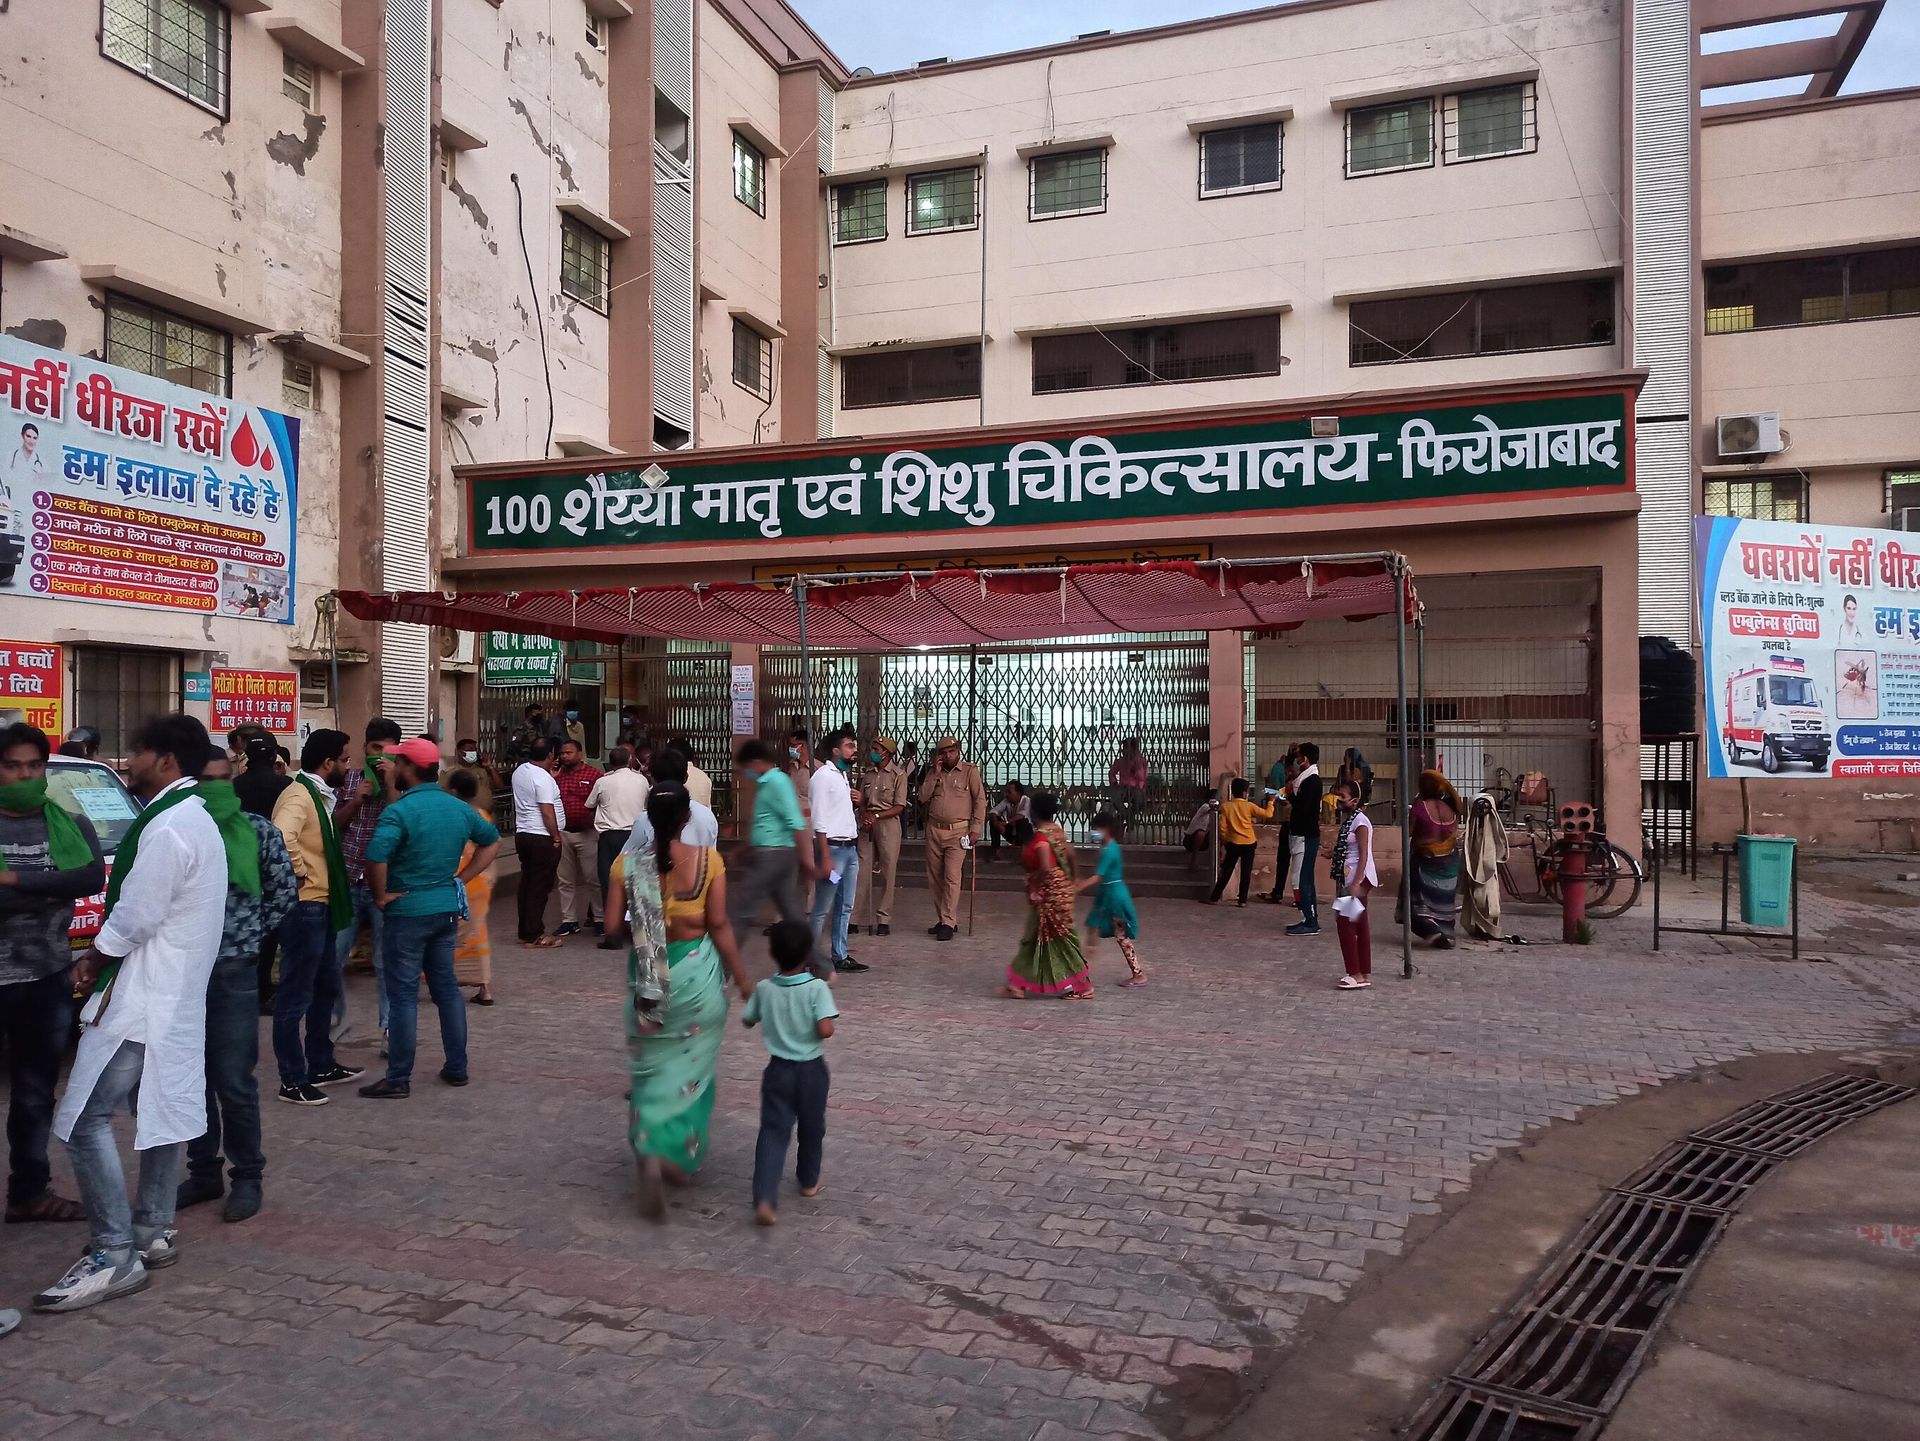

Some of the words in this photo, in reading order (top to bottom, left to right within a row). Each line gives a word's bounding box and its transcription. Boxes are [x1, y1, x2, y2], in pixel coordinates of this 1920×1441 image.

[77, 373, 165, 443] धीरज
[173, 402, 227, 457] रखें
[62, 445, 108, 485] हम
[115, 457, 197, 502] इलाज
[204, 466, 222, 507] दे
[229, 474, 258, 514] रहे
[260, 479, 280, 518] है
[487, 494, 551, 535] 100
[692, 478, 785, 539] मातृ
[792, 457, 867, 519] एवं
[874, 450, 996, 526] शिशु
[54, 498, 77, 510] ब्लड
[79, 500, 98, 513] बैंक
[101, 506, 122, 518] जाने
[124, 509, 136, 520] के
[138, 511, 158, 524] लिये
[201, 523, 219, 535] सेवा
[53, 519, 81, 532] अपने
[83, 522, 111, 536] मरीज
[113, 526, 125, 538] के
[127, 528, 148, 541] लिये
[150, 534, 173, 546] पहले
[174, 538, 192, 551] खुद
[230, 546, 242, 558] की
[244, 549, 264, 561] पहल
[53, 539, 87, 553] एडमिट
[89, 545, 121, 558] फाइल
[122, 548, 134, 559] के
[136, 551, 156, 563] साथ
[180, 557, 199, 569] कार्ड
[1740, 534, 1822, 584] घबरायें
[1827, 538, 1873, 586] नहीं
[1879, 541, 1920, 589] धीर
[50, 561, 66, 571] एक
[91, 564, 101, 575] के
[121, 568, 142, 581] केवल
[144, 571, 152, 582] दो
[89, 583, 103, 595] की
[105, 587, 135, 599] फाइल
[163, 592, 173, 603] से
[1751, 590, 1767, 605] जाने
[1768, 591, 1777, 605] के
[1777, 592, 1794, 607] लिये
[1782, 613, 1817, 635] सुविधा
[1873, 606, 1903, 635] हम
[16, 648, 55, 669] बच्चों
[487, 656, 514, 671] सहायता
[513, 656, 527, 670] कर
[527, 656, 550, 670] सकता
[9, 673, 44, 693] लिये
[214, 672, 236, 694] मरीजों
[266, 679, 277, 695] का
[26, 702, 57, 729] वार्ड
[215, 699, 232, 714] सुबह
[234, 700, 244, 711] 11
[246, 697, 253, 711] से
[255, 700, 265, 712] 12
[266, 698, 279, 712] बजे
[280, 701, 293, 712] तक
[1839, 761, 1875, 775] स्वशासी
[1877, 764, 1900, 774] राज्य
